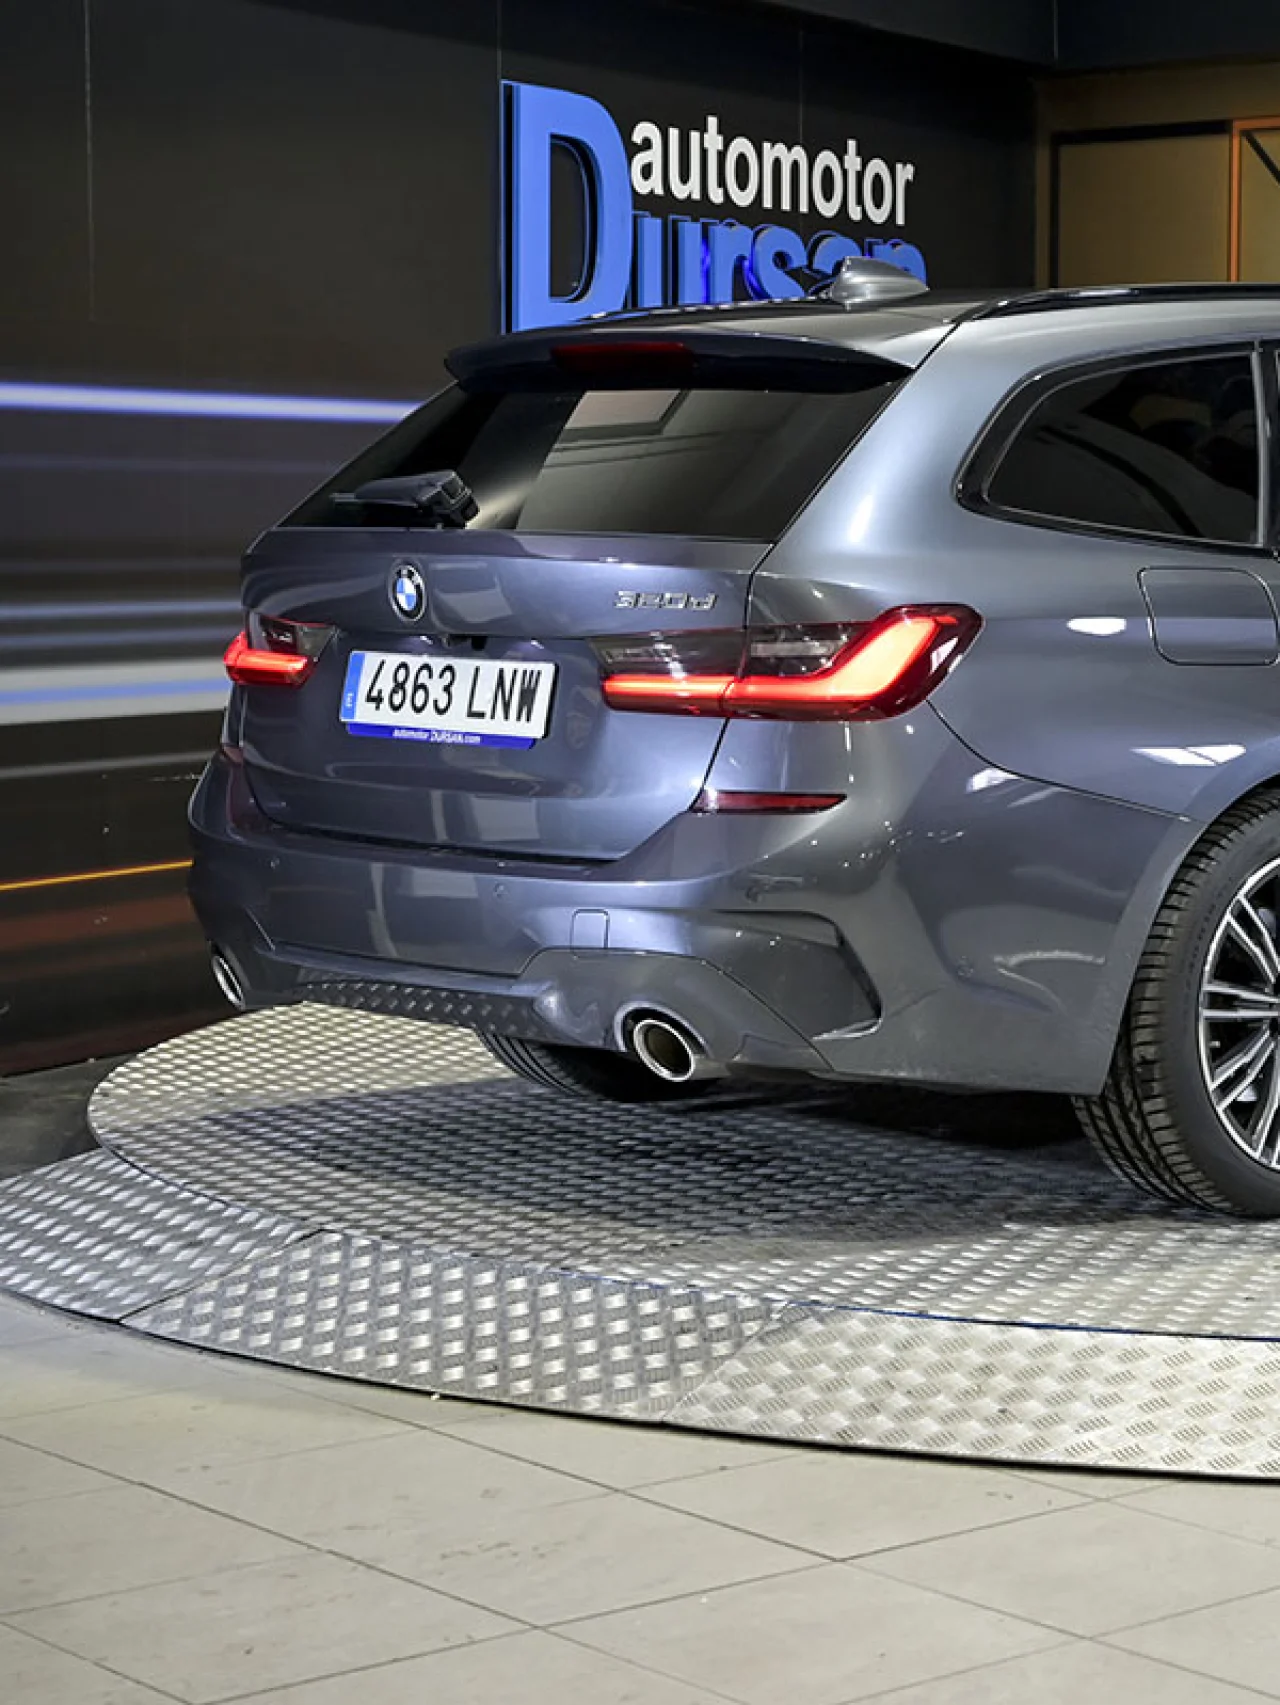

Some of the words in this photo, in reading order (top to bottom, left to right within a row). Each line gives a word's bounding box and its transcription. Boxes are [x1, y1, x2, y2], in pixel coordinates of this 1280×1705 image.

[630, 115, 914, 225] automotor
[365, 659, 456, 716] 4863
[466, 665, 542, 723] LNW
